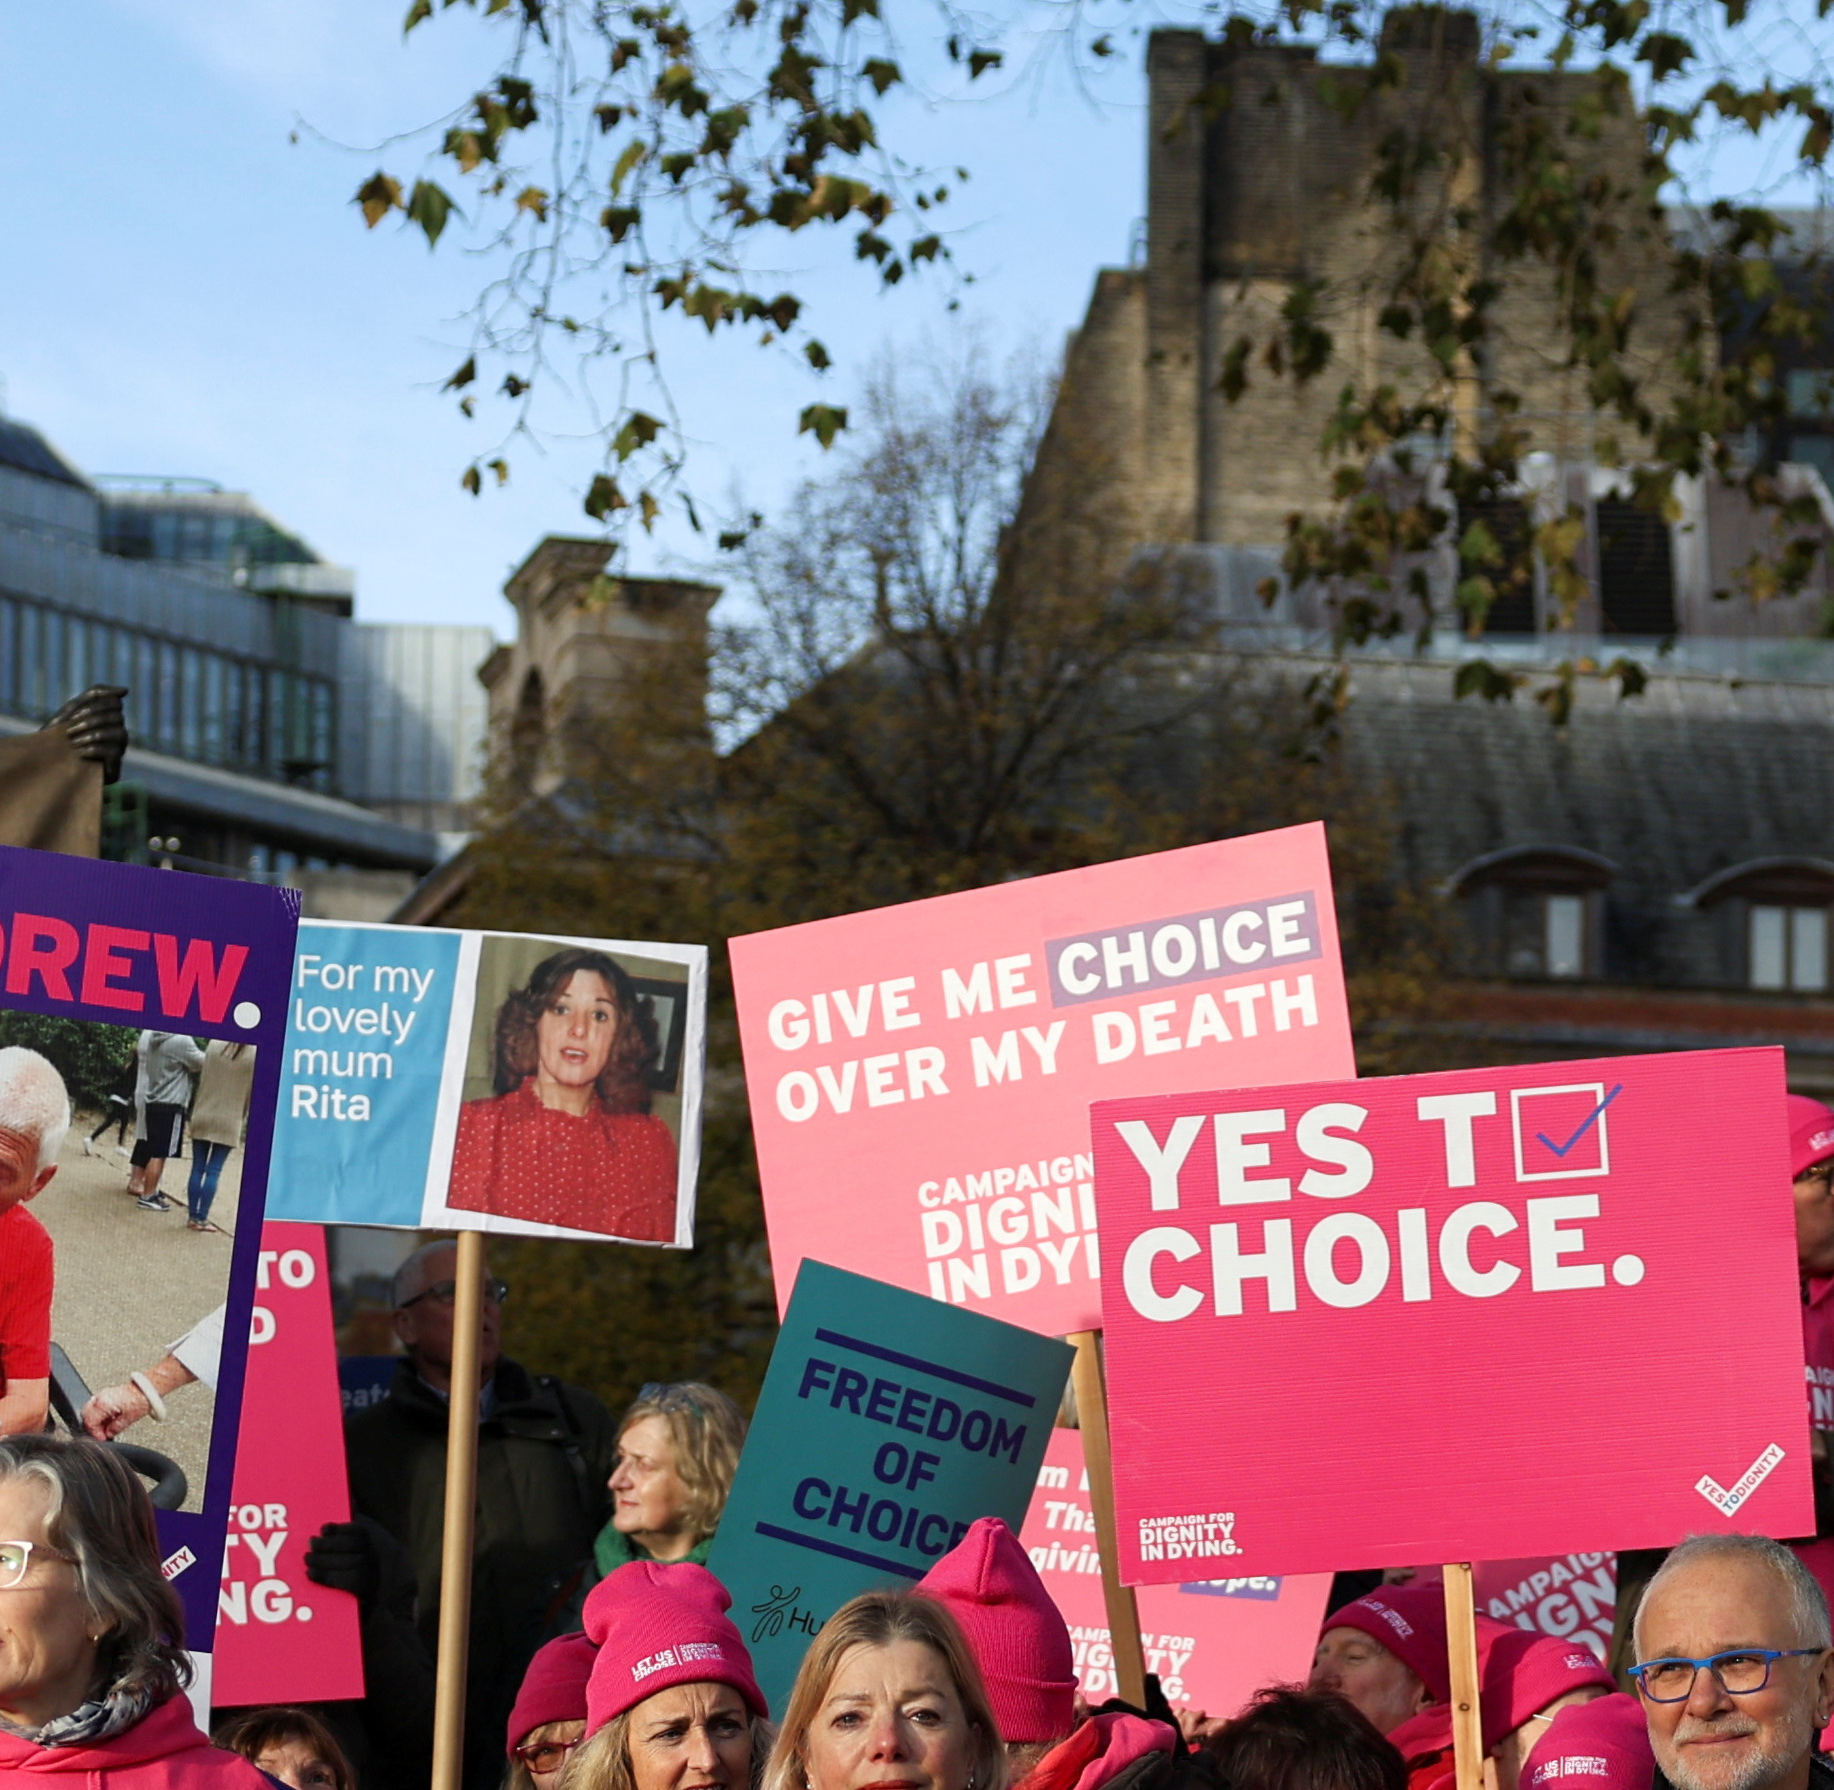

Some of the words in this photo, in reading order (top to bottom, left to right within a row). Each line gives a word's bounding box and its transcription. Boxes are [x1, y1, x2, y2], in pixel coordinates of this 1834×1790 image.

[297, 954, 361, 990] For
[375, 965, 434, 1002] my
[767, 976, 921, 1052] GIVE
[941, 954, 1037, 1021] ME
[1057, 900, 1311, 995] CHOICE
[295, 999, 416, 1045] lovely
[293, 1049, 392, 1079] mum
[775, 1046, 949, 1123] OVER
[970, 1020, 1066, 1087] MY
[1092, 975, 1318, 1064] DEATH
[291, 1085, 370, 1121] Rita
[1115, 1103, 1373, 1213] YES
[920, 1181, 1098, 1259] DIGNI
[1122, 1194, 1645, 1323] CHOICE.
[927, 1262, 991, 1302] IN
[798, 1358, 1027, 1464] FREEDOM
[873, 1442, 941, 1491] OF
[1701, 1480, 1725, 1503] YES
[1044, 1501, 1096, 1532] Tha
[1139, 1514, 1205, 1527] CAMPAIGN
[1209, 1512, 1235, 1523] FOR
[1140, 1522, 1235, 1544] DIGNITY
[1141, 1544, 1163, 1561] IN
[1167, 1539, 1244, 1559] DYING.
[631, 1656, 653, 1676] LET
[655, 1649, 673, 1662] US
[1158, 1636, 1195, 1652] FOR
[634, 1658, 677, 1682] CHOOSE
